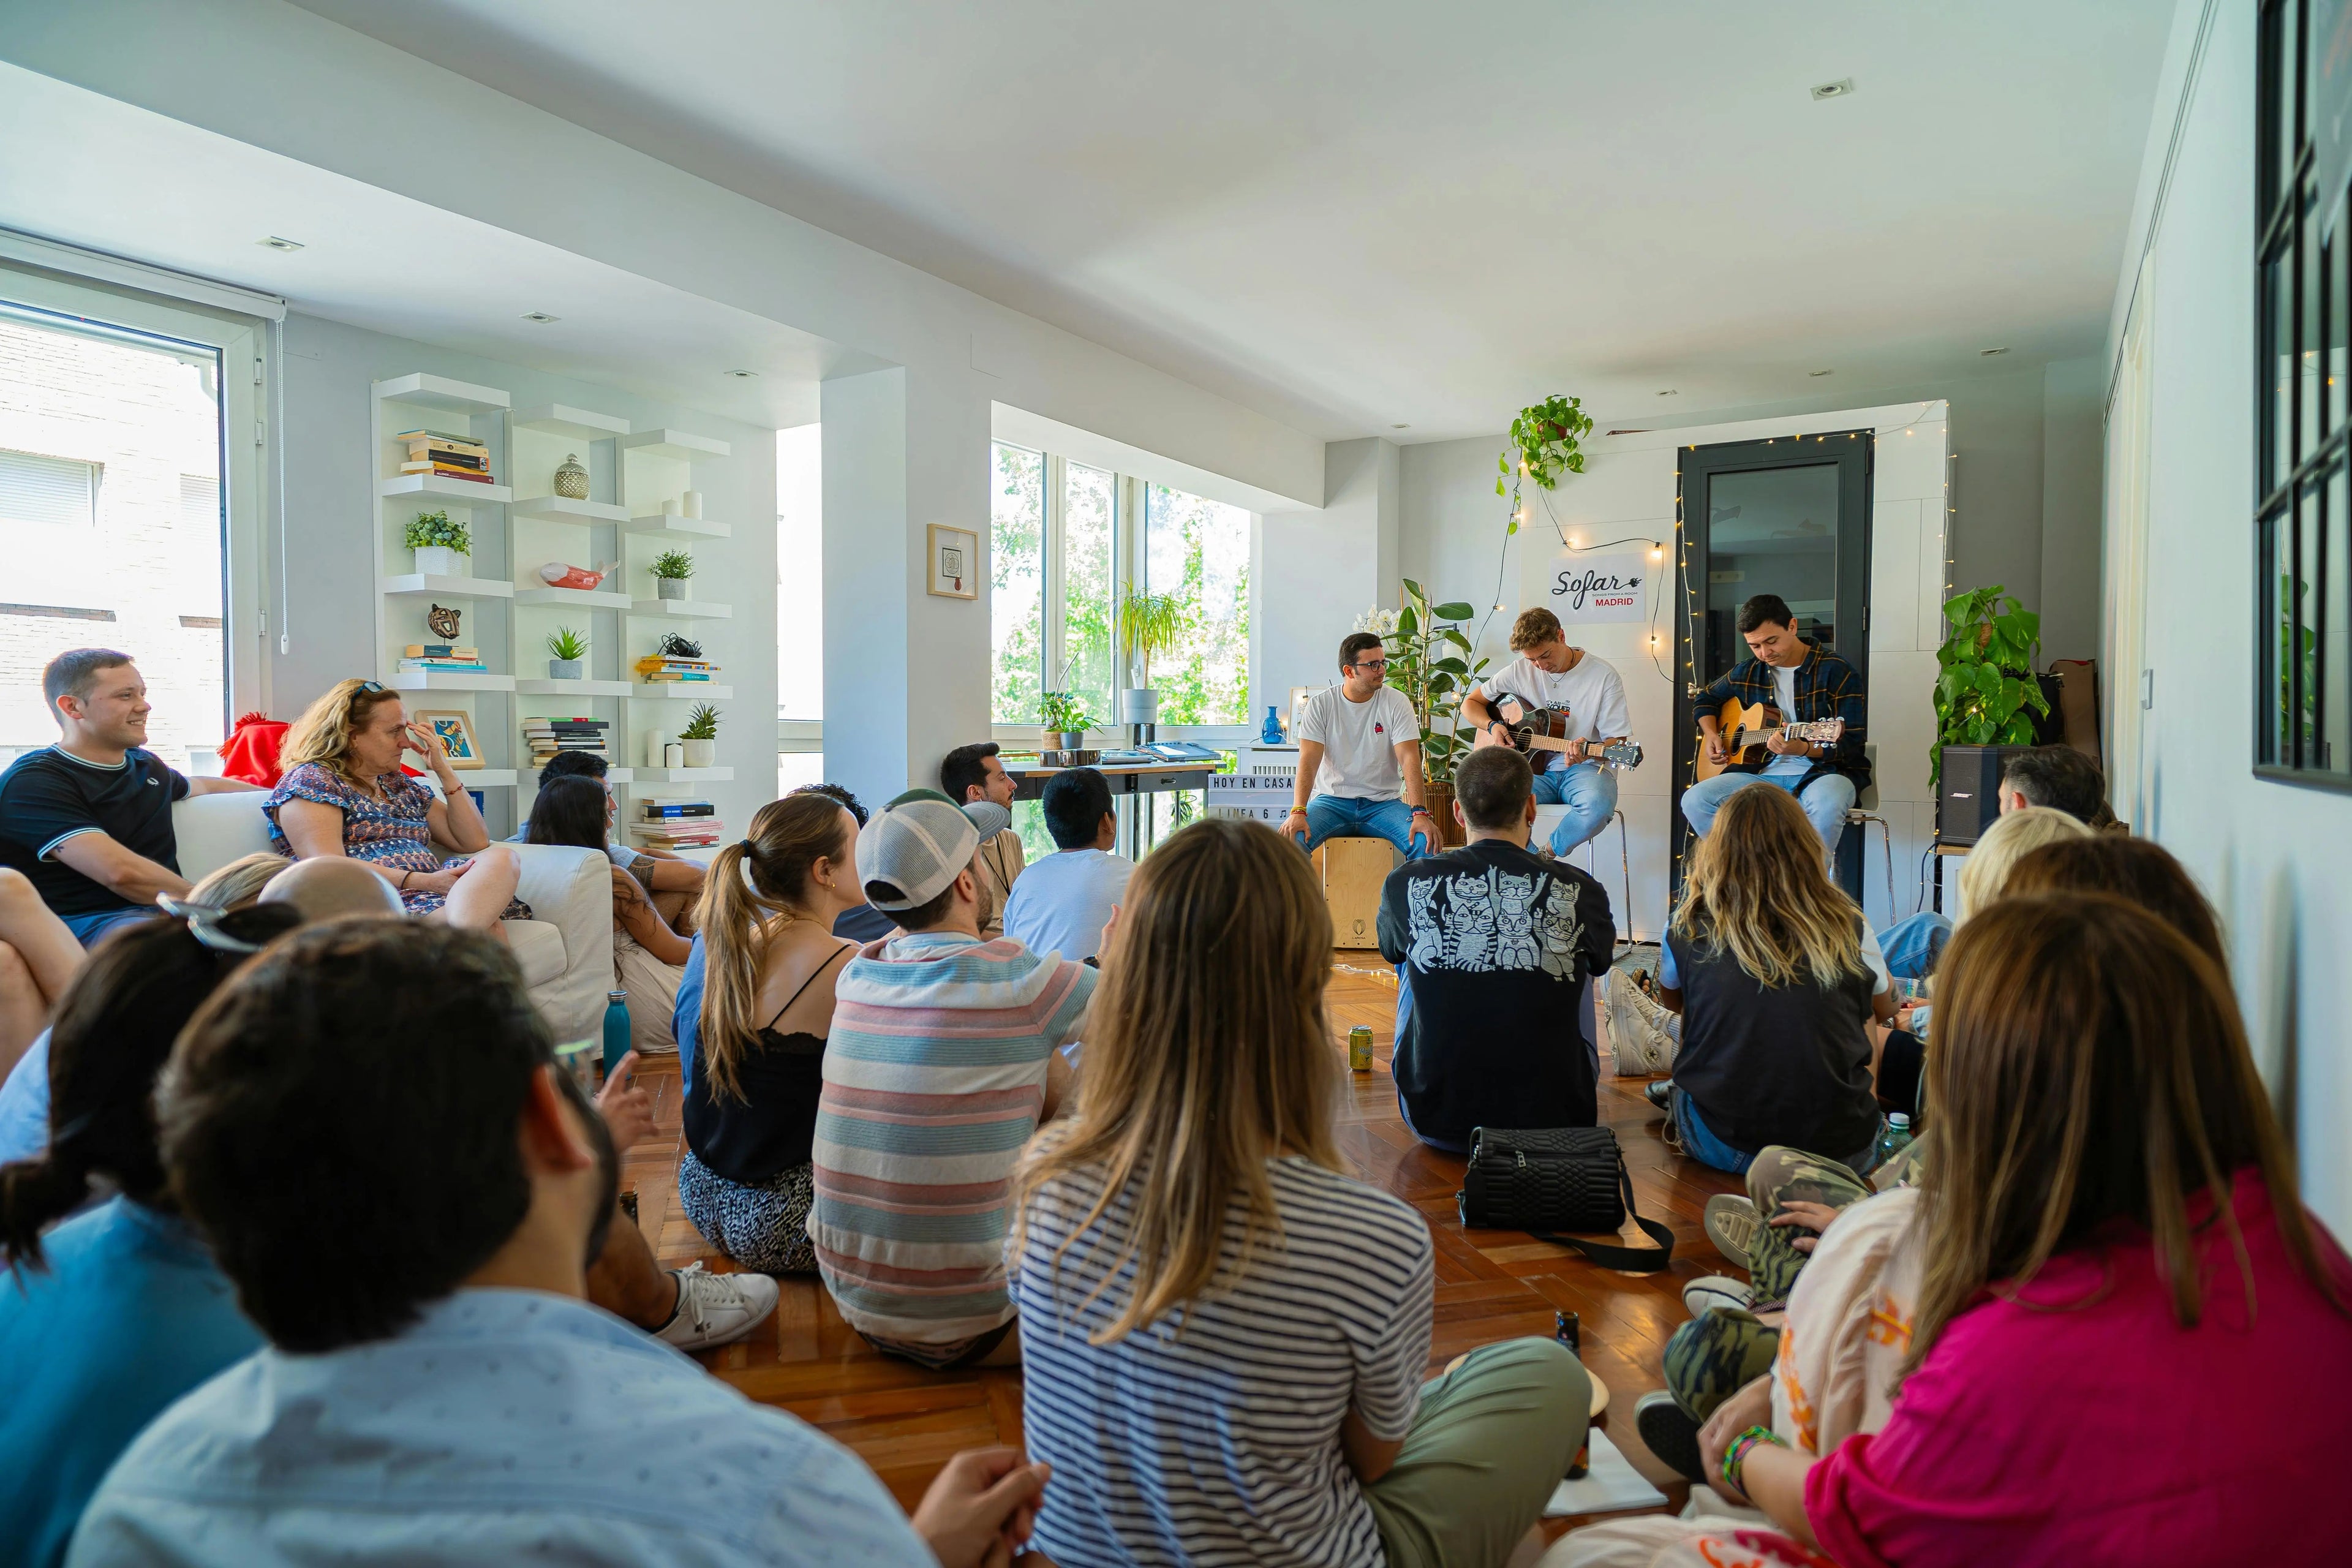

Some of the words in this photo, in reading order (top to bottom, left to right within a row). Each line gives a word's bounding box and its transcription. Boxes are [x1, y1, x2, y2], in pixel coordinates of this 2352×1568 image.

[1552, 570, 1622, 610] Sofar
[1596, 598, 1633, 606] MADRID
[1213, 777, 1235, 788] HOY
[1242, 778, 1256, 788] EN
[1264, 778, 1292, 788] CASA
[1263, 809, 1268, 819] 6
